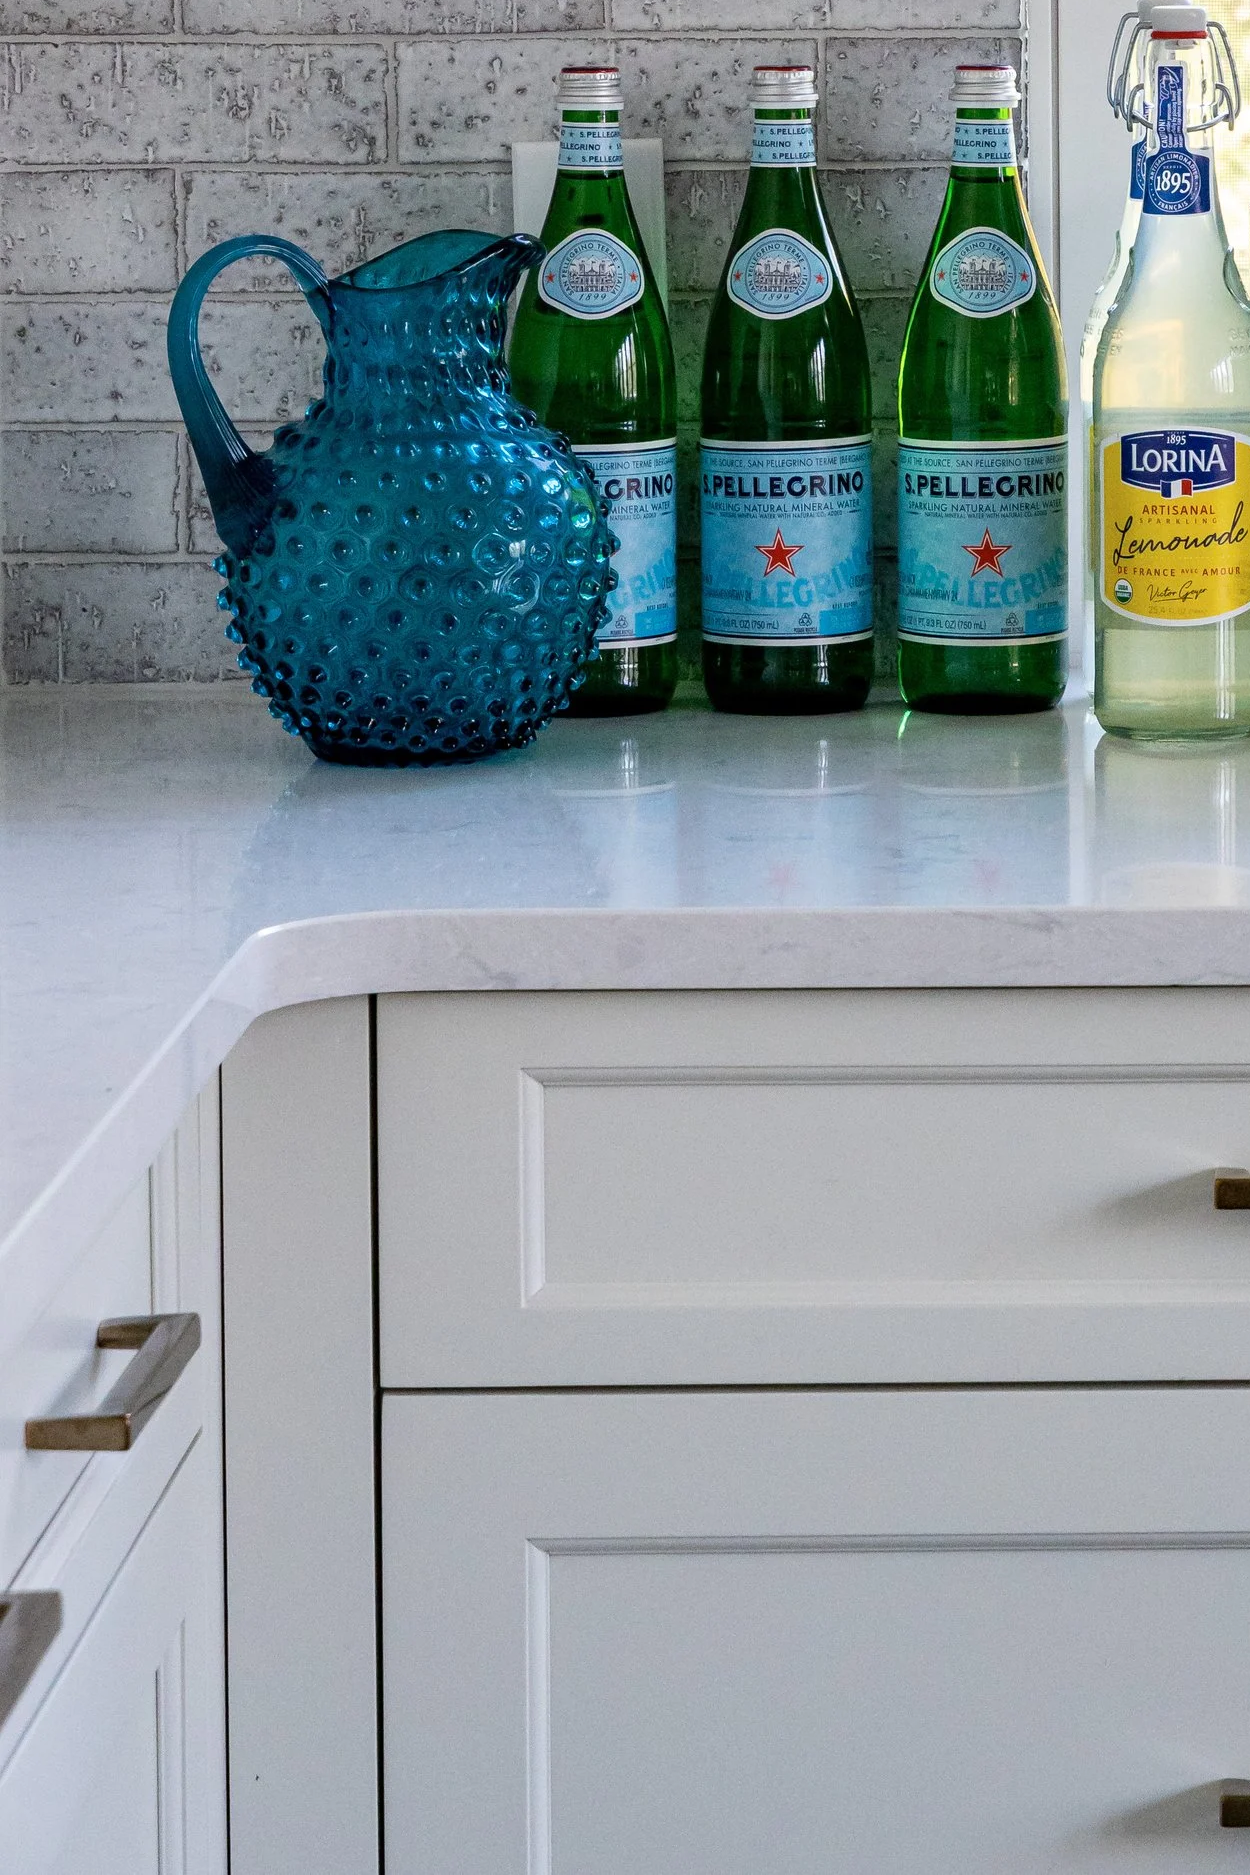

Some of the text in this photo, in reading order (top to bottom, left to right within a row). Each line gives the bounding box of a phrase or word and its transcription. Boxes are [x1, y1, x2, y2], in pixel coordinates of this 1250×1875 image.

[1150, 156, 1165, 180] ARTISAN
[1156, 170, 1191, 194] 1895
[597, 243, 619, 263] TERME
[784, 244, 805, 263] TERME
[988, 242, 1010, 262] TERME
[579, 293, 607, 301] 1899
[762, 293, 790, 301] 1899
[968, 291, 997, 300] 1899
[1166, 434, 1187, 446] 1895
[632, 460, 652, 469] TERME
[748, 459, 764, 468] SAN
[766, 459, 813, 468] PELLEGRINO
[816, 457, 837, 466] TERME
[956, 459, 973, 468] SAN
[975, 459, 1021, 468] PELLEGRINO
[1024, 457, 1044, 466] TERME
[703, 470, 865, 500] S.PELLEGRINO
[905, 471, 1065, 500] S.PELLEGRINO
[611, 501, 670, 514] MINERAL WATER
[743, 503, 788, 513] NATURAL
[791, 502, 834, 512] MINERAL
[837, 499, 860, 509] WATER
[908, 499, 1062, 513] SPARKLING NATURAL MINERAL WATER
[1142, 505, 1216, 516] ARTISANAL
[1139, 517, 1218, 525] SPARKLING
[1112, 500, 1249, 566] Lemonade
[1117, 565, 1128, 575] DE
[1133, 567, 1176, 577] FRANCE
[1202, 566, 1241, 577] AMOUR
[957, 620, 972, 630] (750
